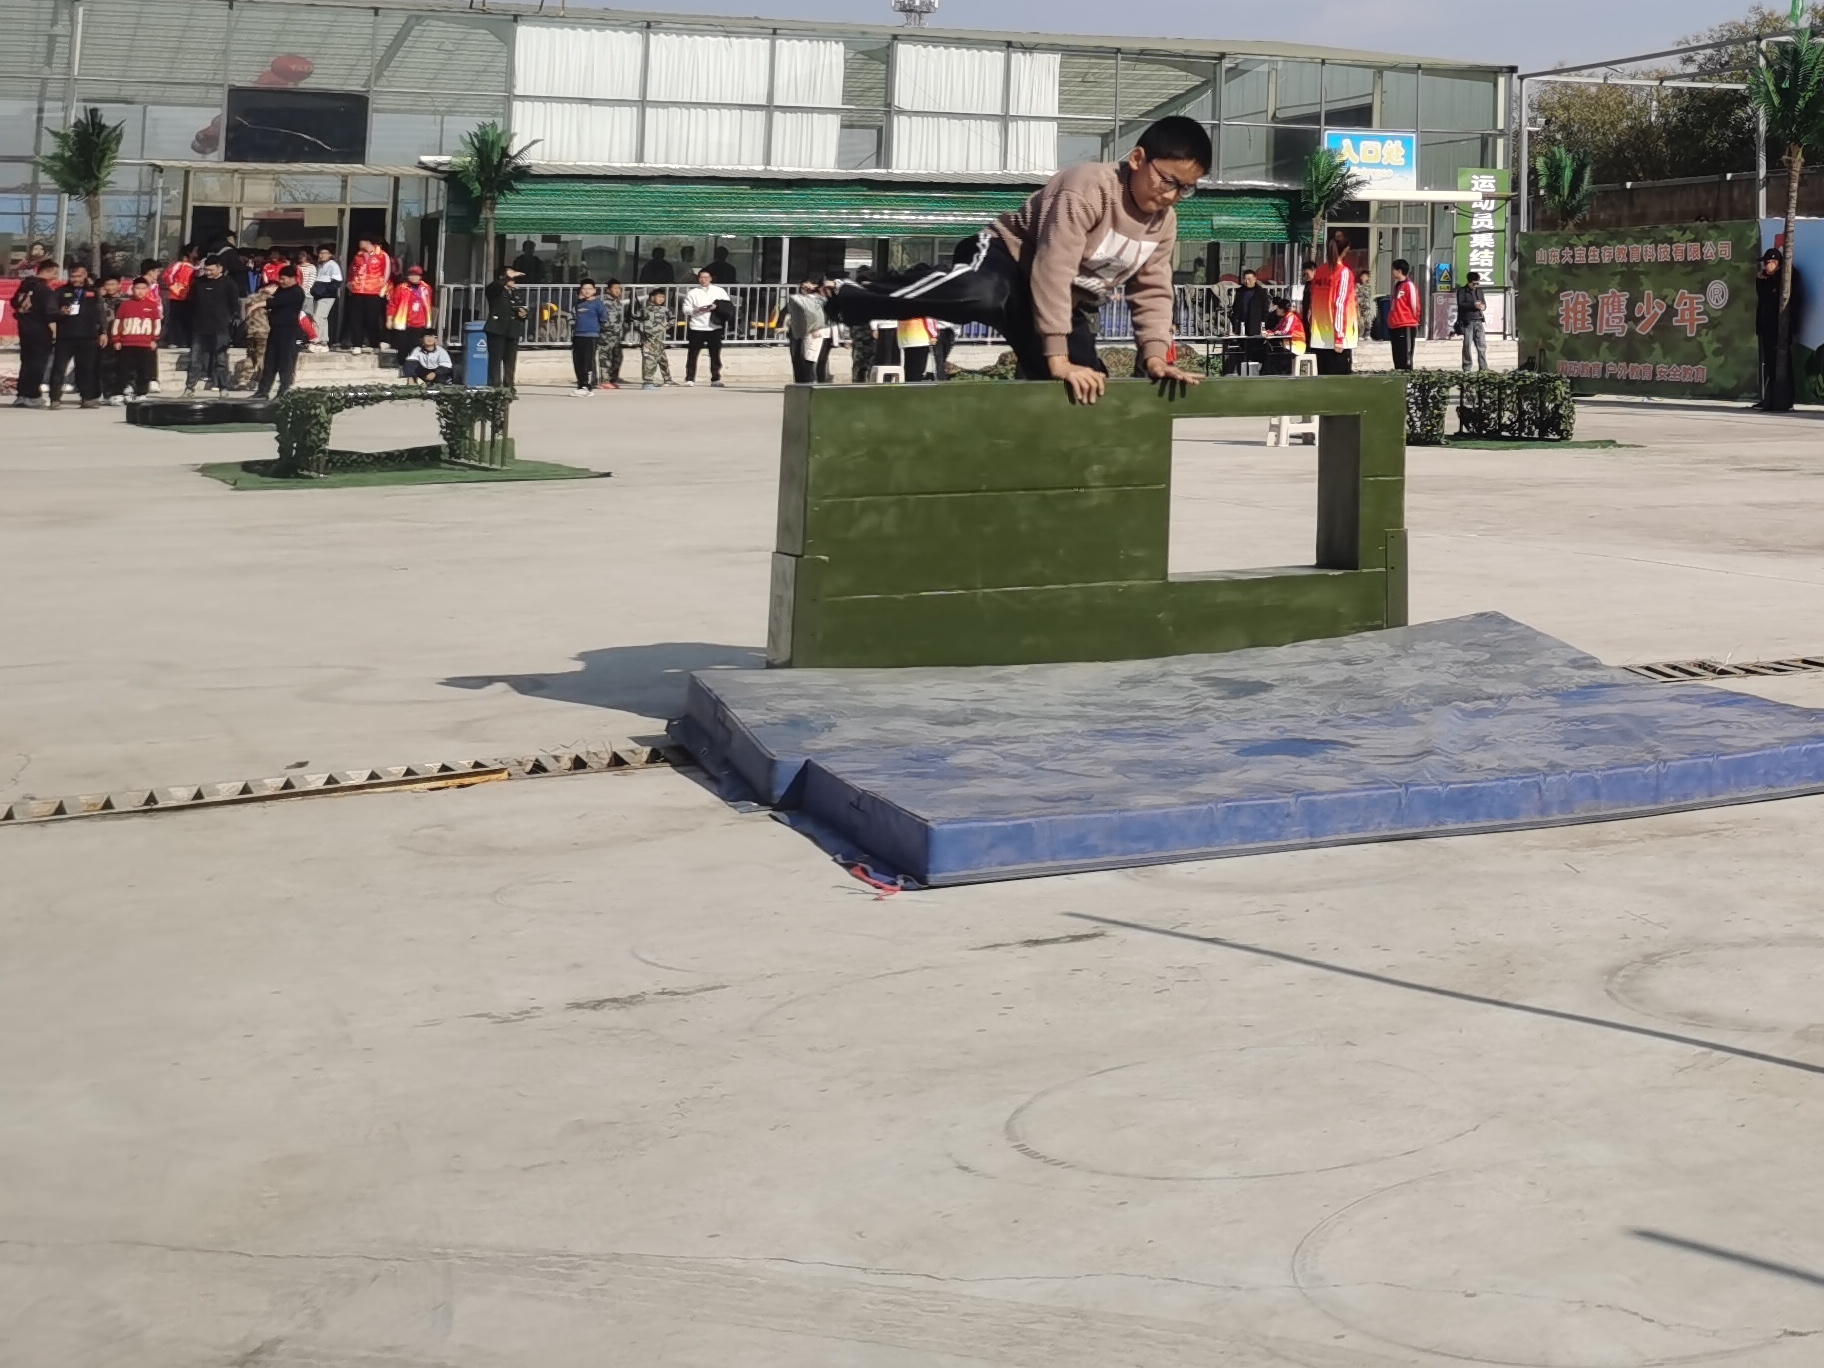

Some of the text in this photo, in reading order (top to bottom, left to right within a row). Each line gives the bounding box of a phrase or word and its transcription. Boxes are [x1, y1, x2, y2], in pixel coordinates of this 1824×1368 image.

[1335, 139, 1405, 166] 入口处
[1535, 241, 1732, 265] 山东大宝生存教育科技有限公司
[1558, 288, 1709, 337] 稚鹰少年
[1605, 362, 1653, 381] 户外教育
[1656, 364, 1708, 383] 安全教育
